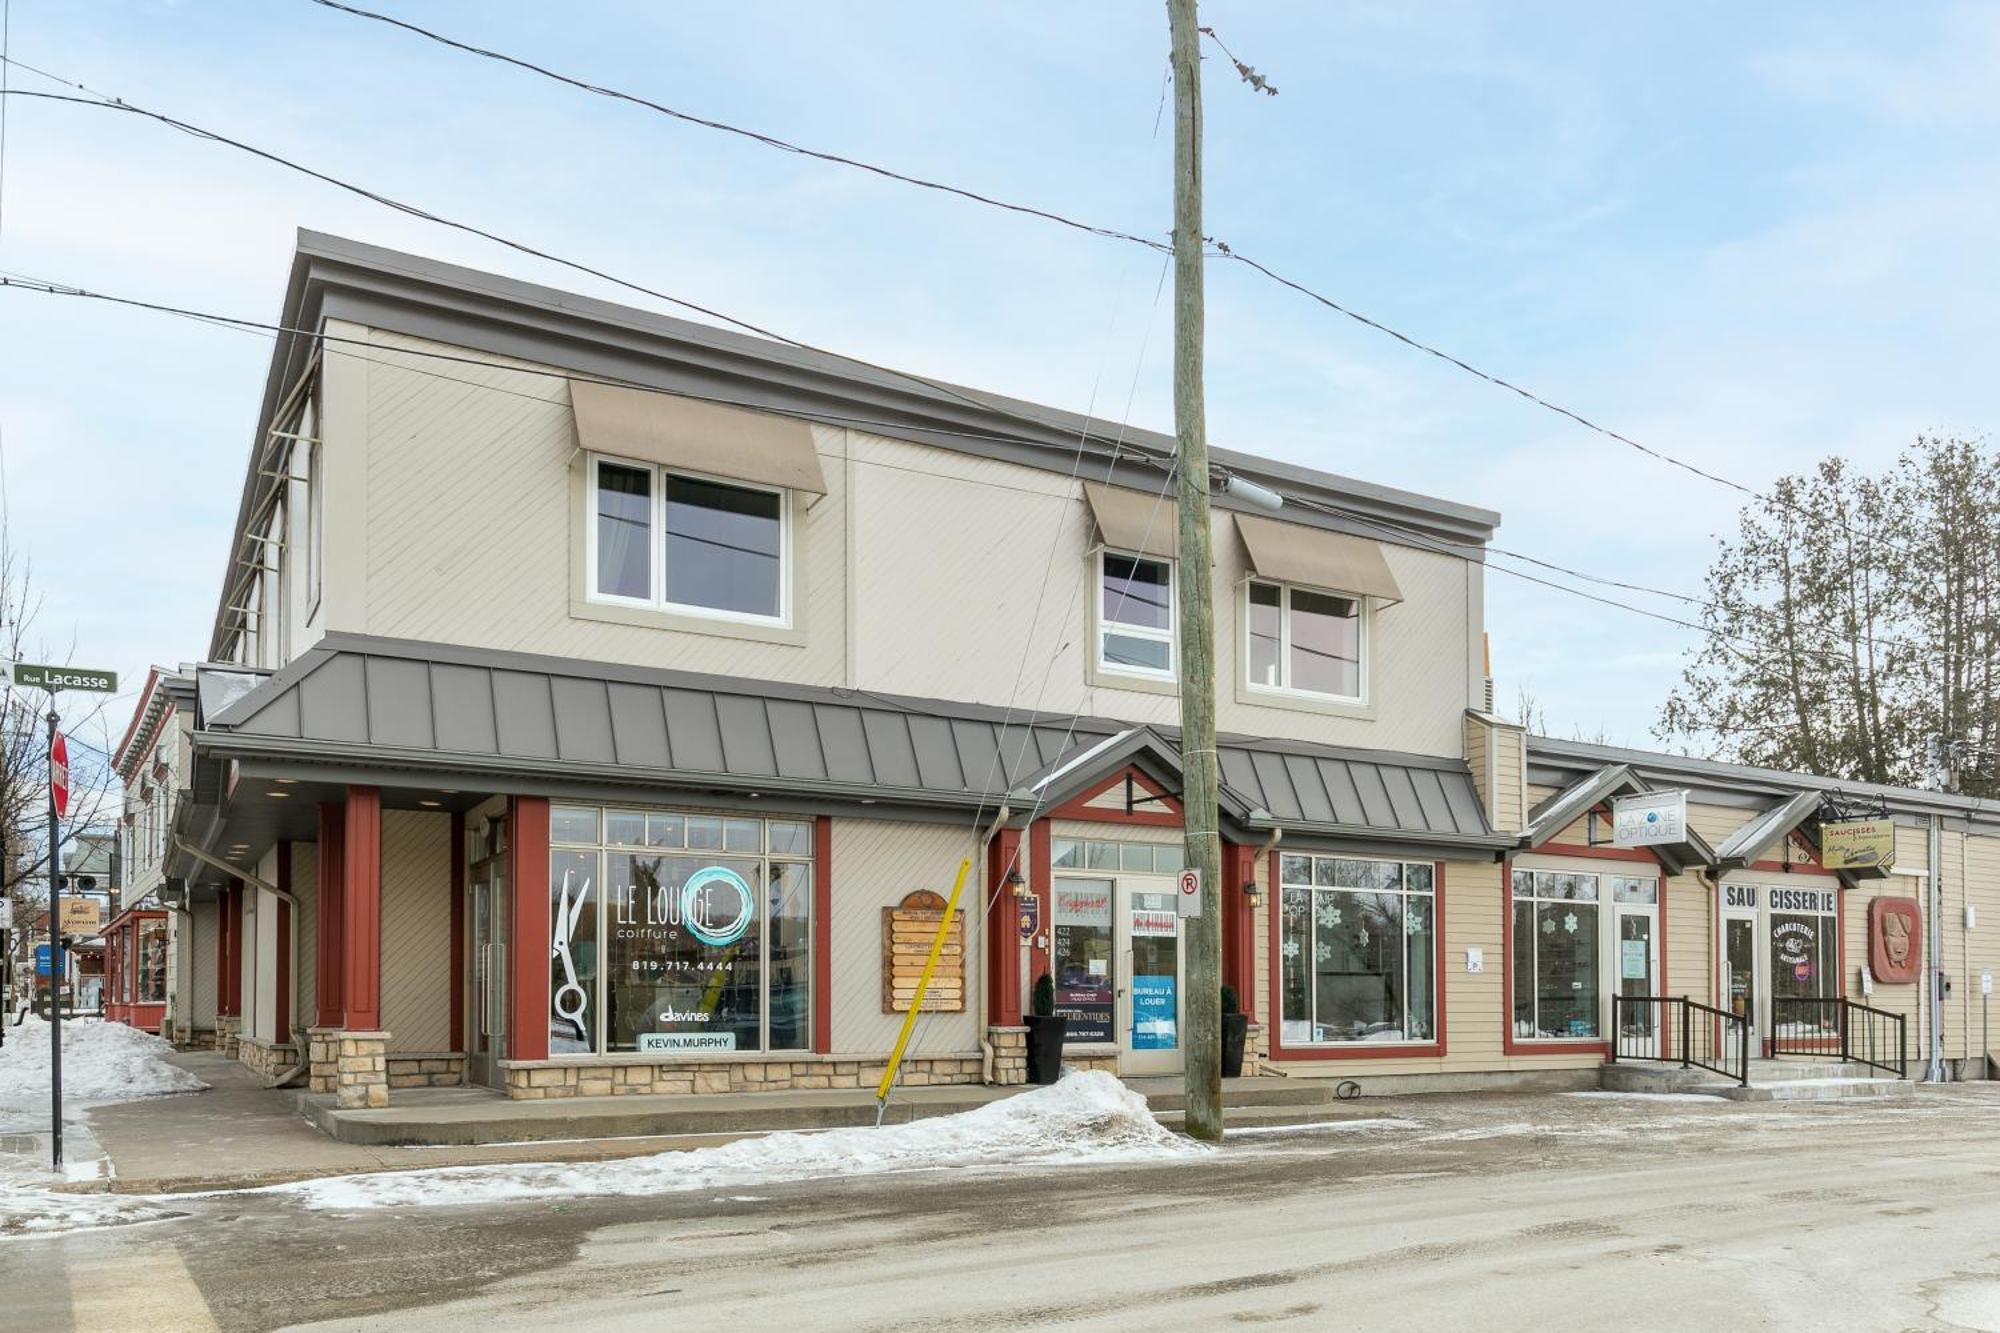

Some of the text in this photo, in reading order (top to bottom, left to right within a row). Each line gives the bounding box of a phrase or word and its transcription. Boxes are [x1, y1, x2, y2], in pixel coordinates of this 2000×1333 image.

[23, 669, 108, 688] Rue Lacasse
[1619, 814, 1635, 828] LA
[1618, 823, 1679, 840] OPTIQUE
[617, 884, 637, 925] LE
[616, 928, 678, 940] coiffure
[632, 960, 733, 972] 819.717.4444
[1133, 987, 1165, 996] BUREAU
[1140, 997, 1166, 1006] LOUER
[659, 1004, 711, 1022] davines
